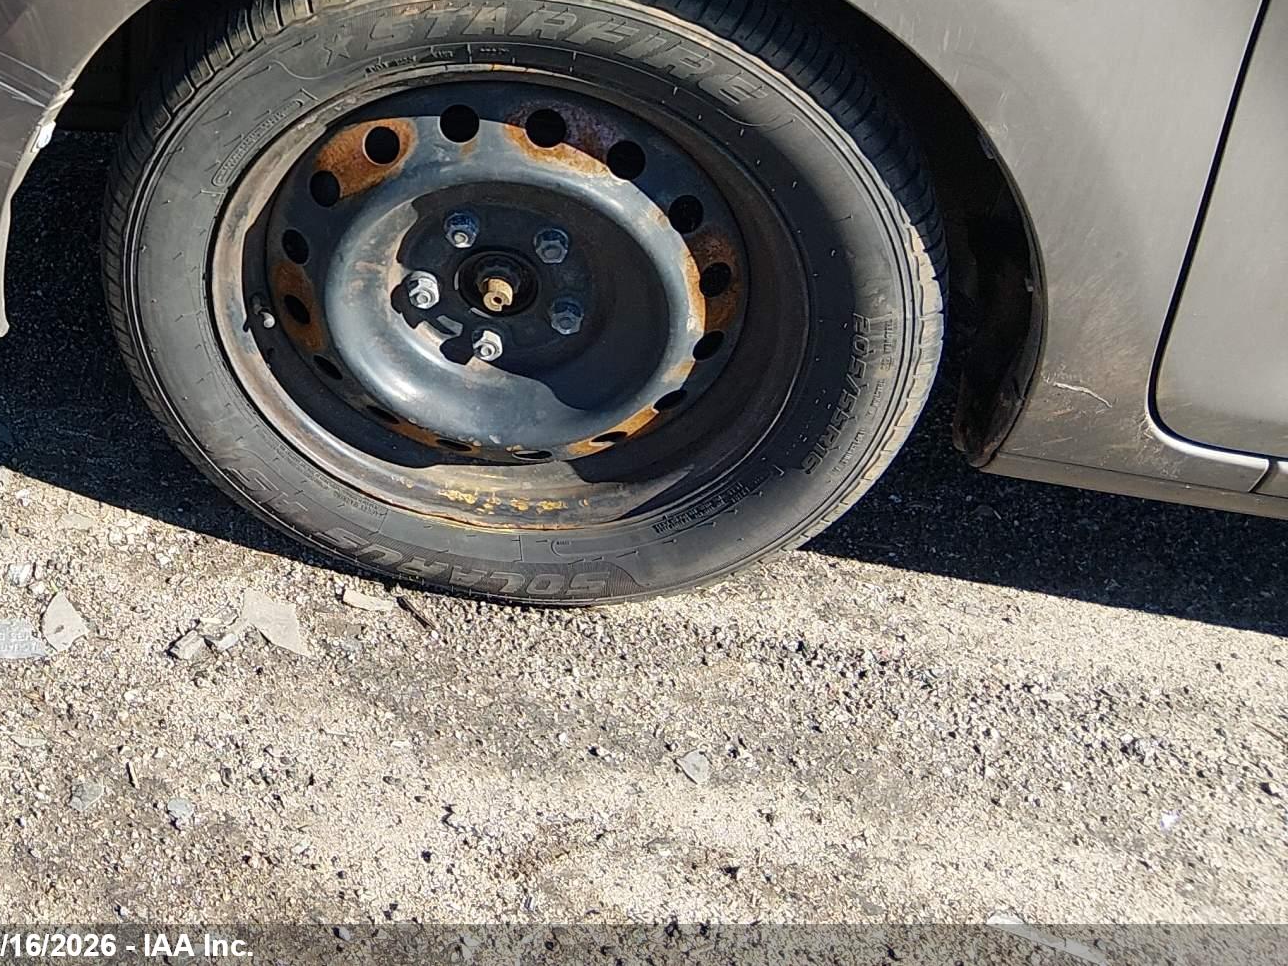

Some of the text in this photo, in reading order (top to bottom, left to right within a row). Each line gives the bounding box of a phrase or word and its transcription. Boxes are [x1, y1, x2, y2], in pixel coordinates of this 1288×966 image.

[364, 0, 772, 106] STARFIRE
[802, 311, 872, 475] 205/55R16
[314, 529, 610, 597] SOLARUS
